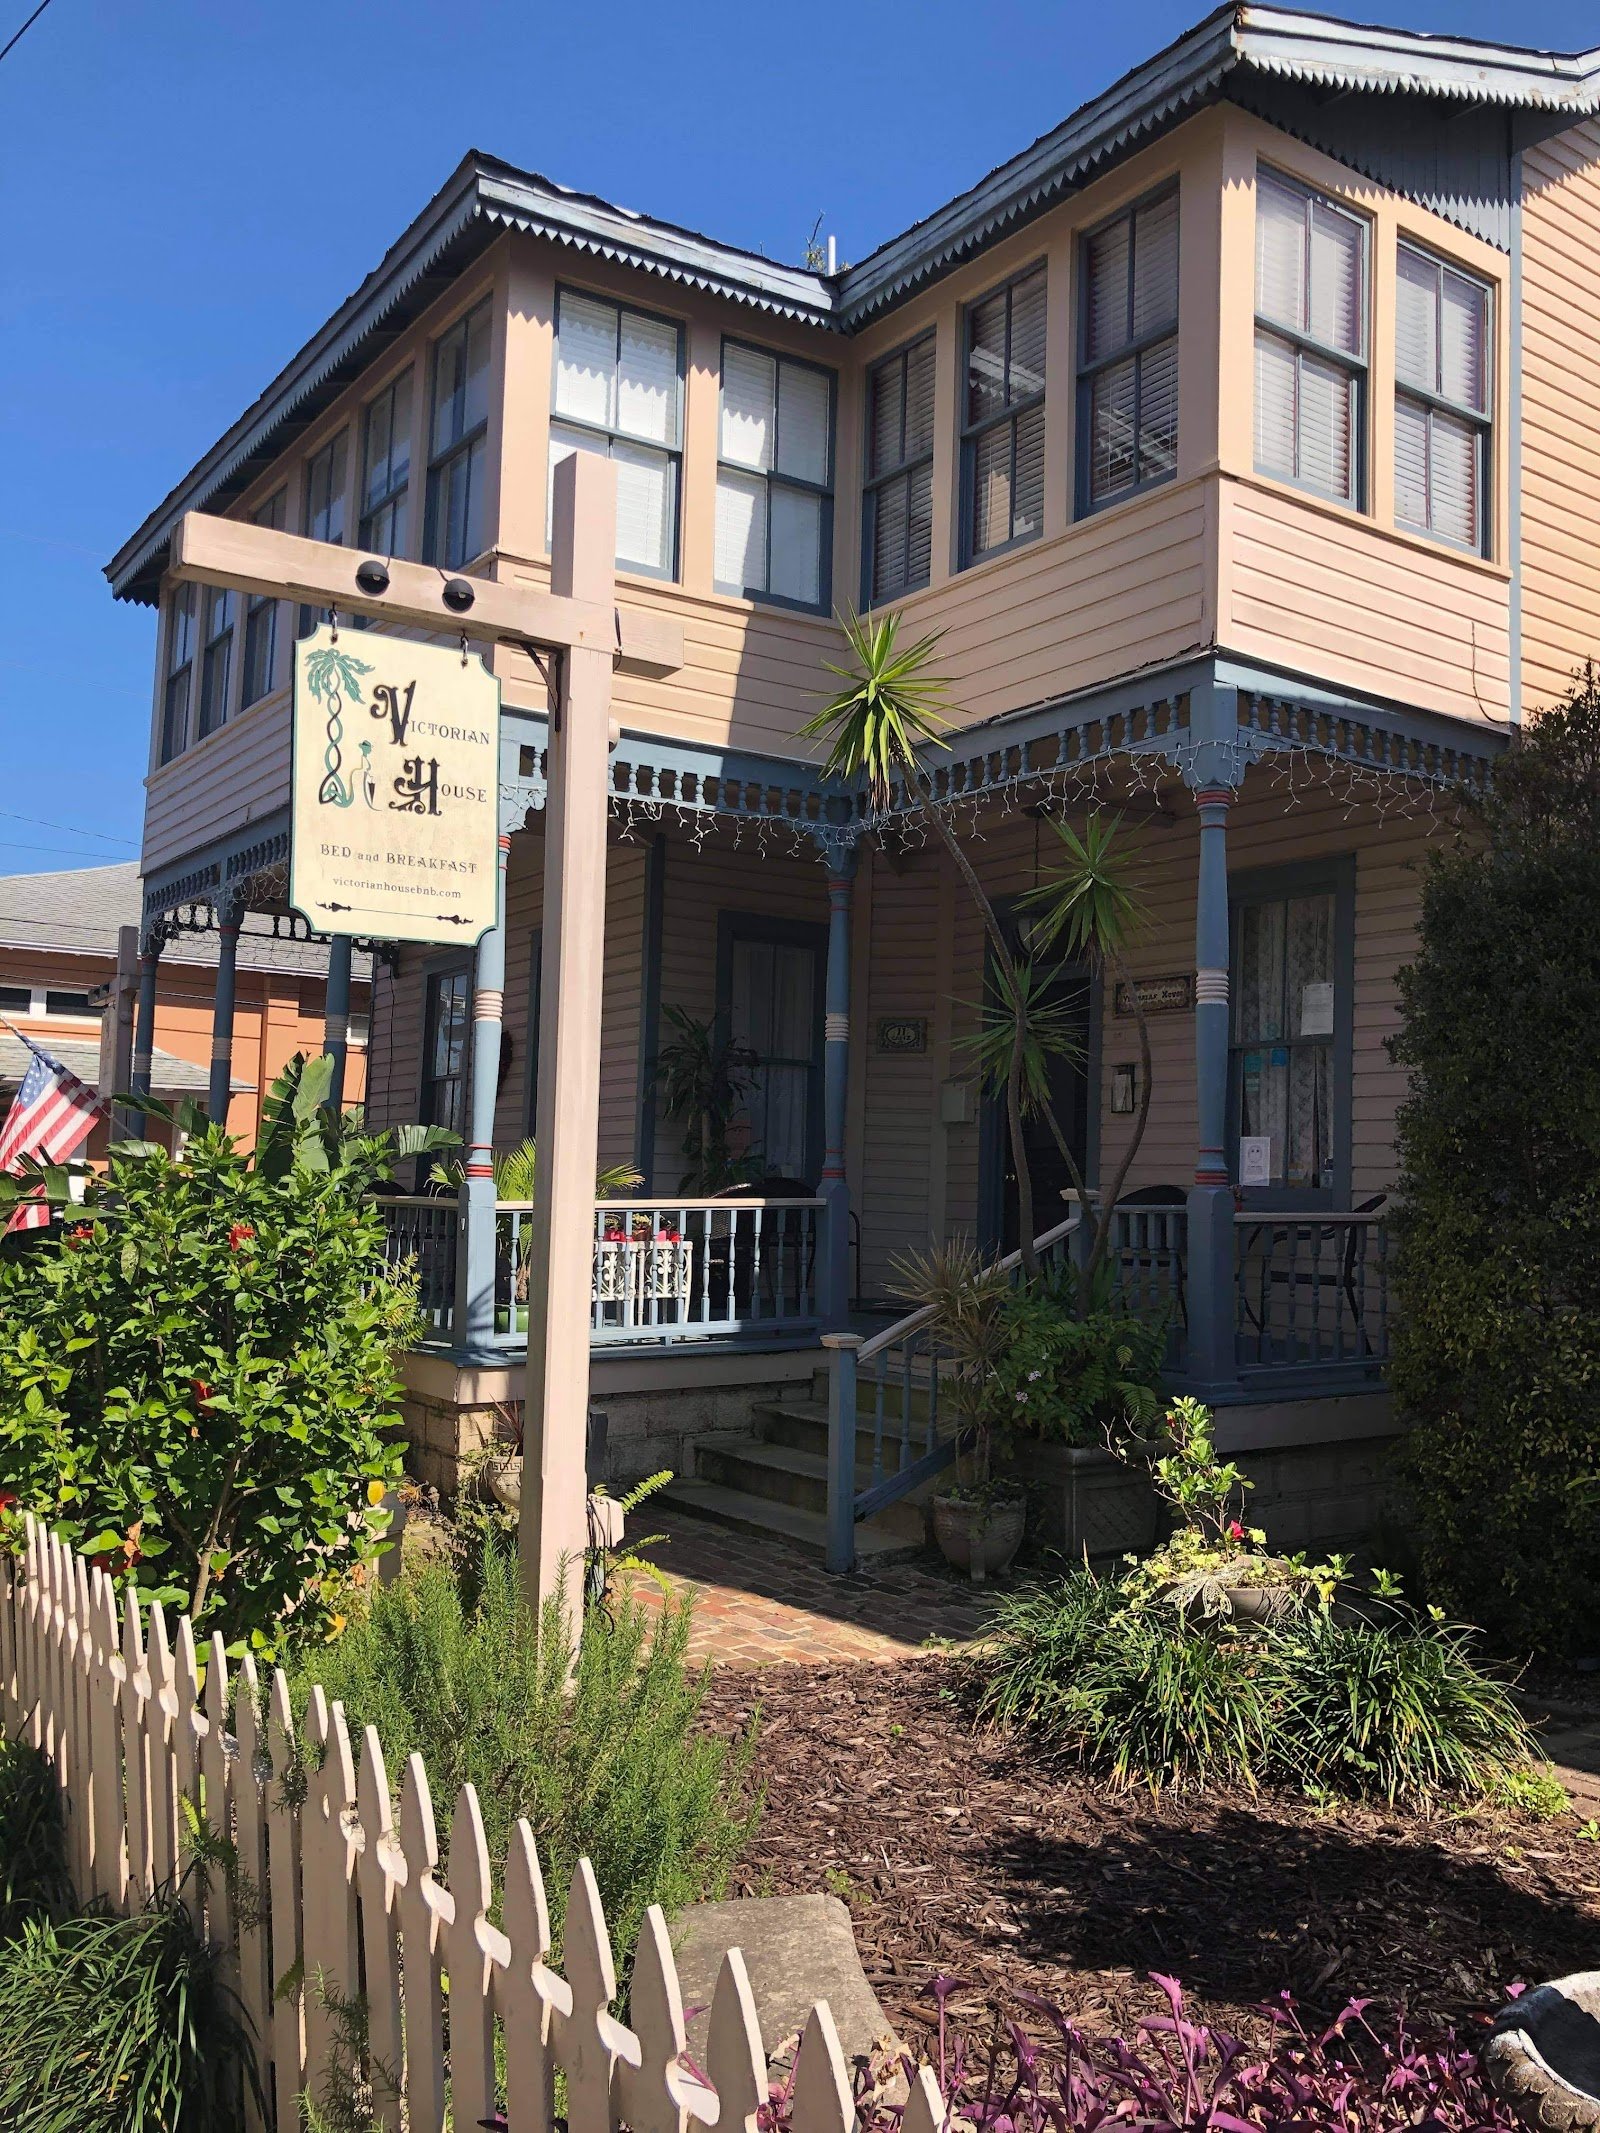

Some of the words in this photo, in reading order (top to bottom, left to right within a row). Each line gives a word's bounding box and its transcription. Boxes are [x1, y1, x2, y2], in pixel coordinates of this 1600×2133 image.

[370, 680, 490, 747] VICTORIAN
[388, 755, 487, 816] HOUSE
[320, 843, 351, 858] BED
[358, 850, 379, 862] and
[386, 852, 478, 874] BREAKFAST
[333, 876, 462, 899] victorianhousebnb.com
